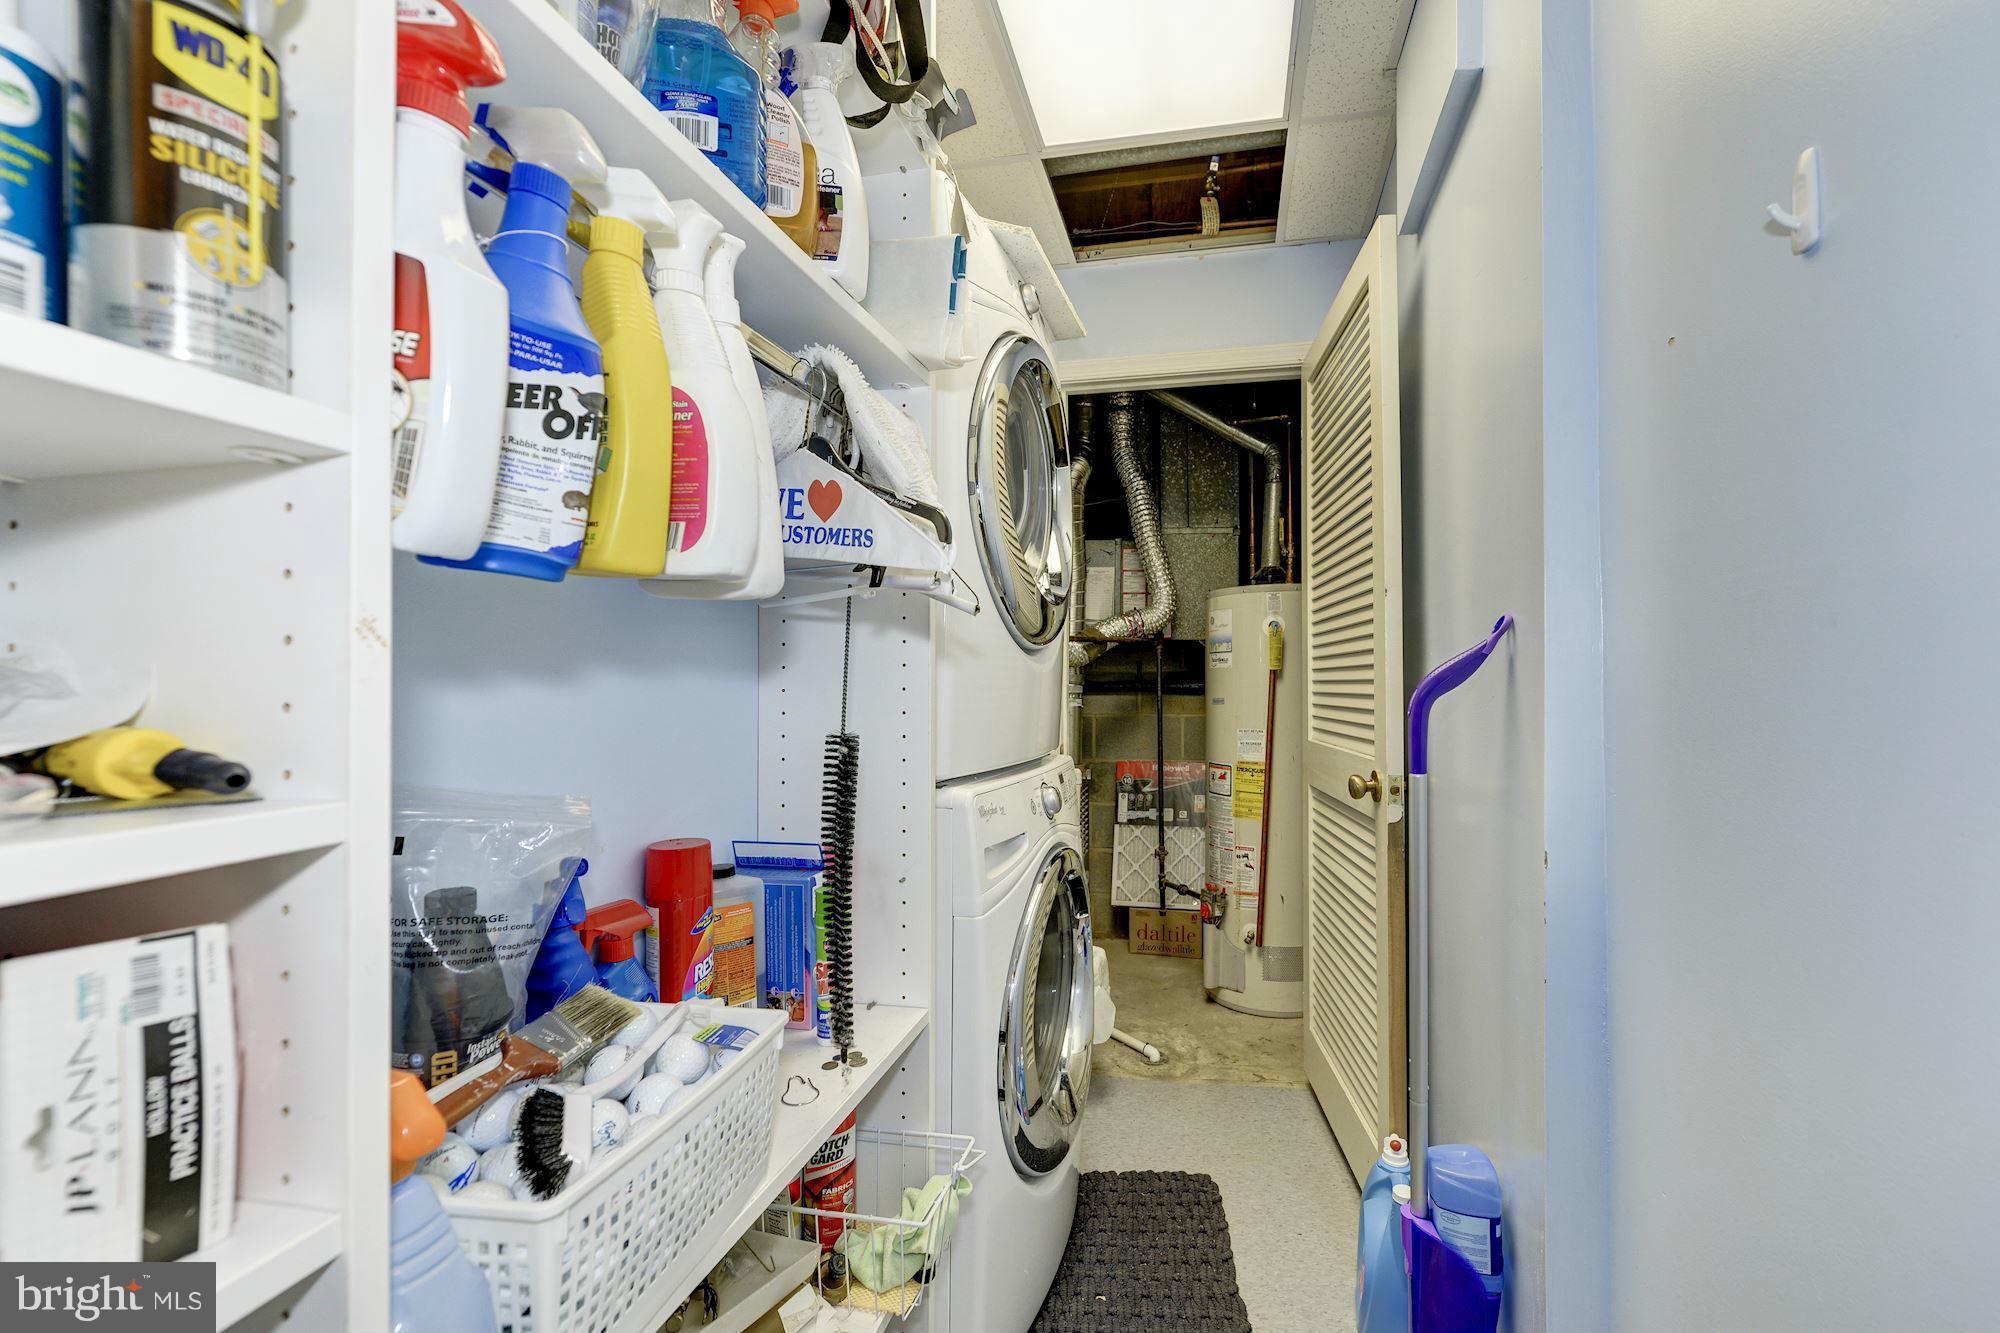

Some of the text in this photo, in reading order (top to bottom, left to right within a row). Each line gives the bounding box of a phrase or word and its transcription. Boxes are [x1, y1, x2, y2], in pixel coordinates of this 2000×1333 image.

[541, 445, 558, 455] and
[1152, 763, 1190, 773] Hneywell
[410, 917, 443, 927] SAFE
[446, 913, 509, 926] STORAGE:
[1136, 922, 1196, 943] daltile
[469, 947, 485, 955] out
[810, 1148, 844, 1166] GARD
[821, 1178, 854, 1195] FABRICS
